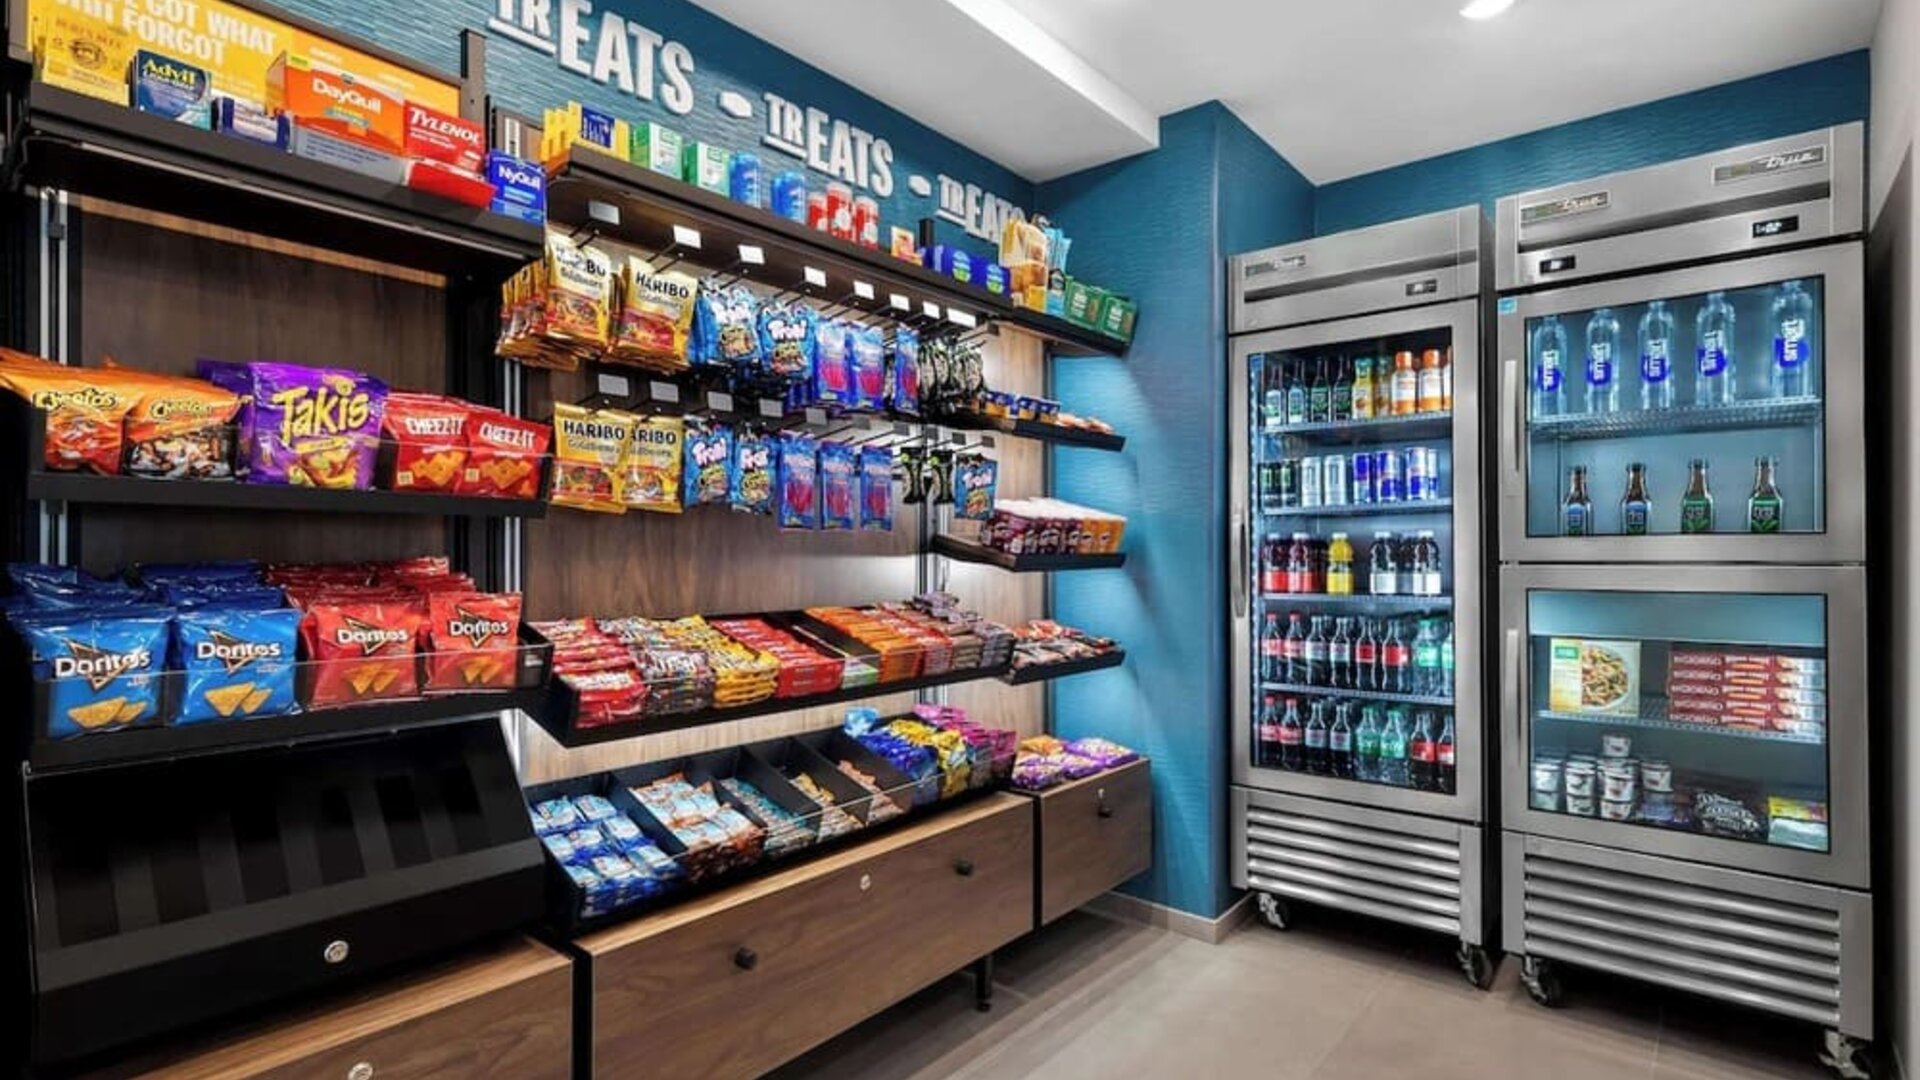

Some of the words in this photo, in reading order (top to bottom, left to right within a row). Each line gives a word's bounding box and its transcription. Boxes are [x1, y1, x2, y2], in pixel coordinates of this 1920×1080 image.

[122, 8, 225, 67] FORGOT
[207, 10, 276, 56] WHAT
[144, 58, 196, 86] Advil
[312, 77, 382, 114] DayQuil
[409, 106, 481, 145] TYLENOL
[763, 92, 894, 197] TREATS
[498, 164, 541, 190] NyQuil
[635, 270, 690, 300] HARIBO
[32, 387, 120, 411] Cheetos
[271, 382, 371, 447] Takis
[563, 420, 626, 441] HARIBO
[631, 427, 677, 445] RIBO
[336, 628, 410, 644] Doritos
[449, 619, 509, 637] Doritos
[55, 649, 151, 678] Doritos
[196, 641, 282, 660] Doritos
